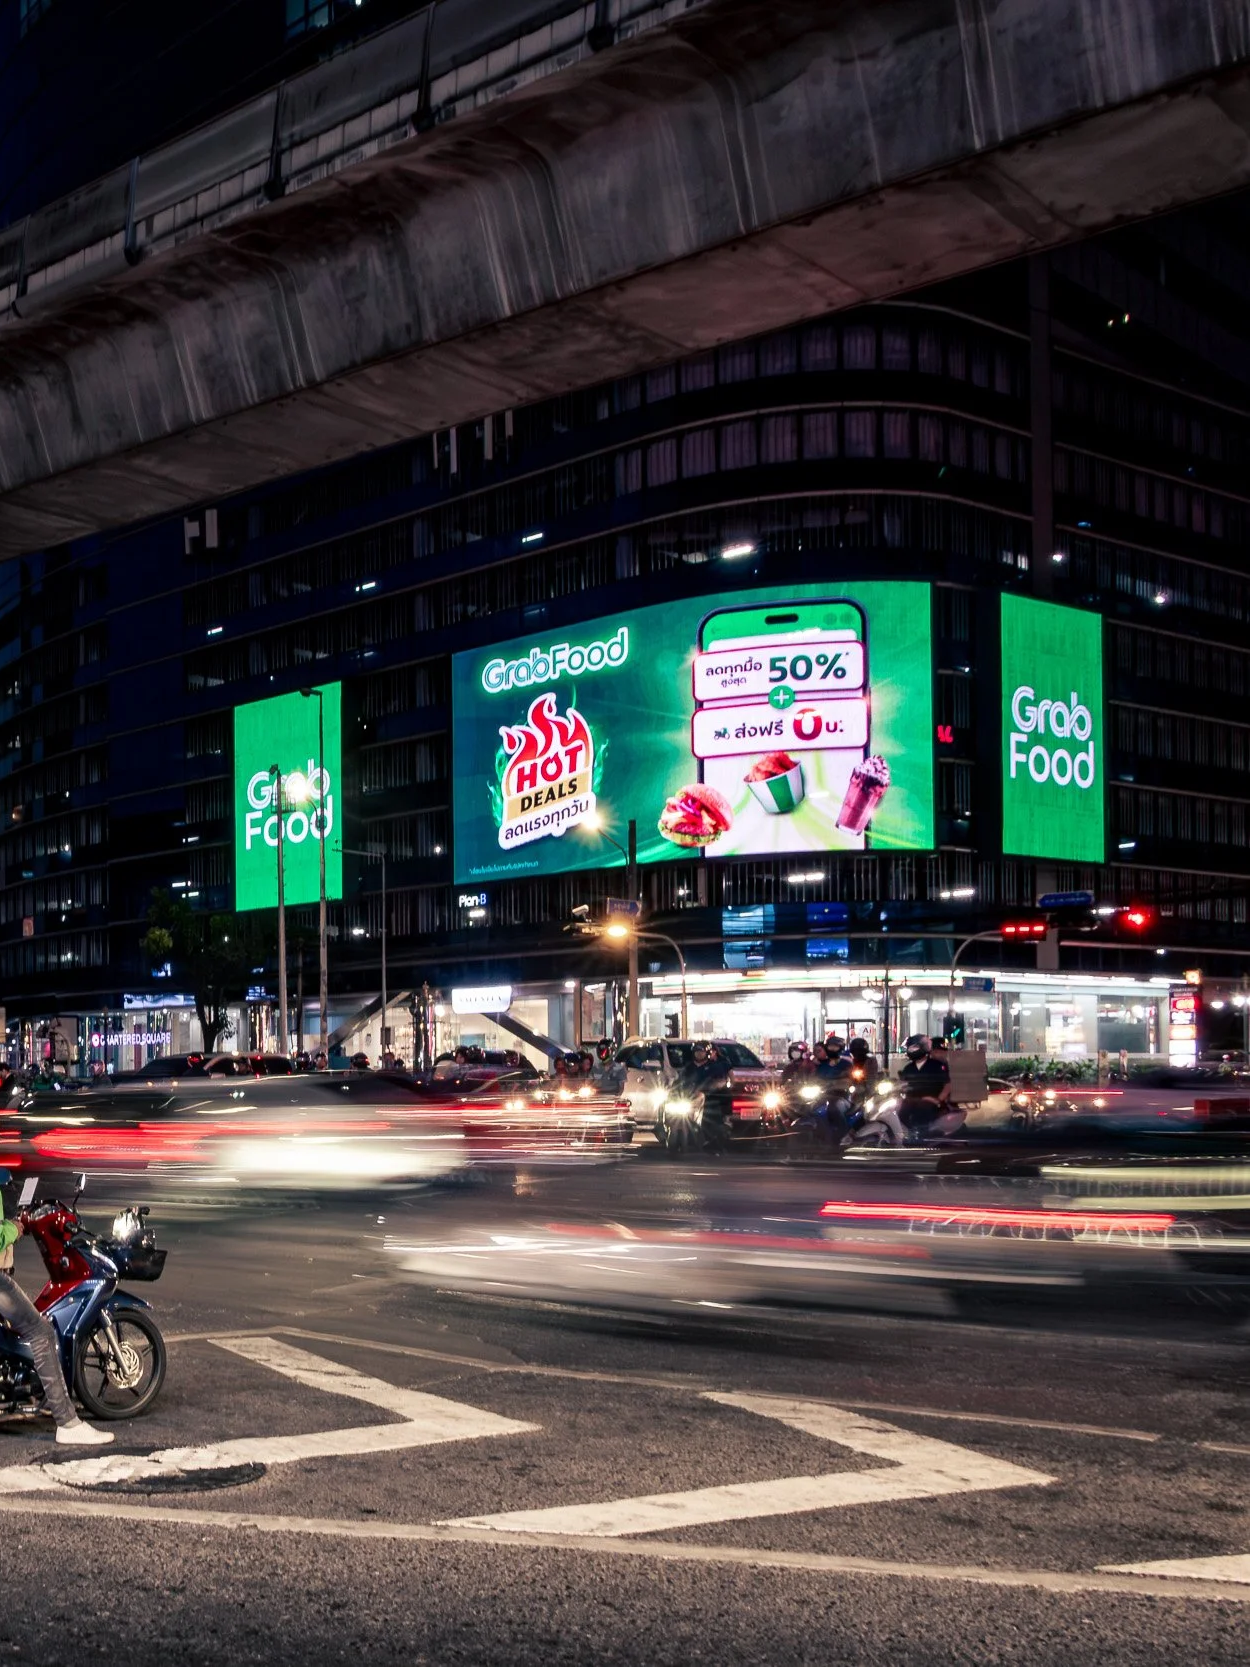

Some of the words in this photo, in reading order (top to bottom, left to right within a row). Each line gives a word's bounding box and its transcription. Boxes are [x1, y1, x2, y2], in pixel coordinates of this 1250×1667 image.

[705, 656, 763, 677] ลดทุกมื้อ
[734, 719, 784, 738] ส่งฟรี
[1011, 685, 1092, 741] Grab
[516, 744, 583, 794] HOT
[1009, 732, 1095, 789] Food
[520, 778, 578, 813] DEALS
[245, 794, 334, 850] Food
[504, 799, 590, 840] ลดแรงทุกวัน
